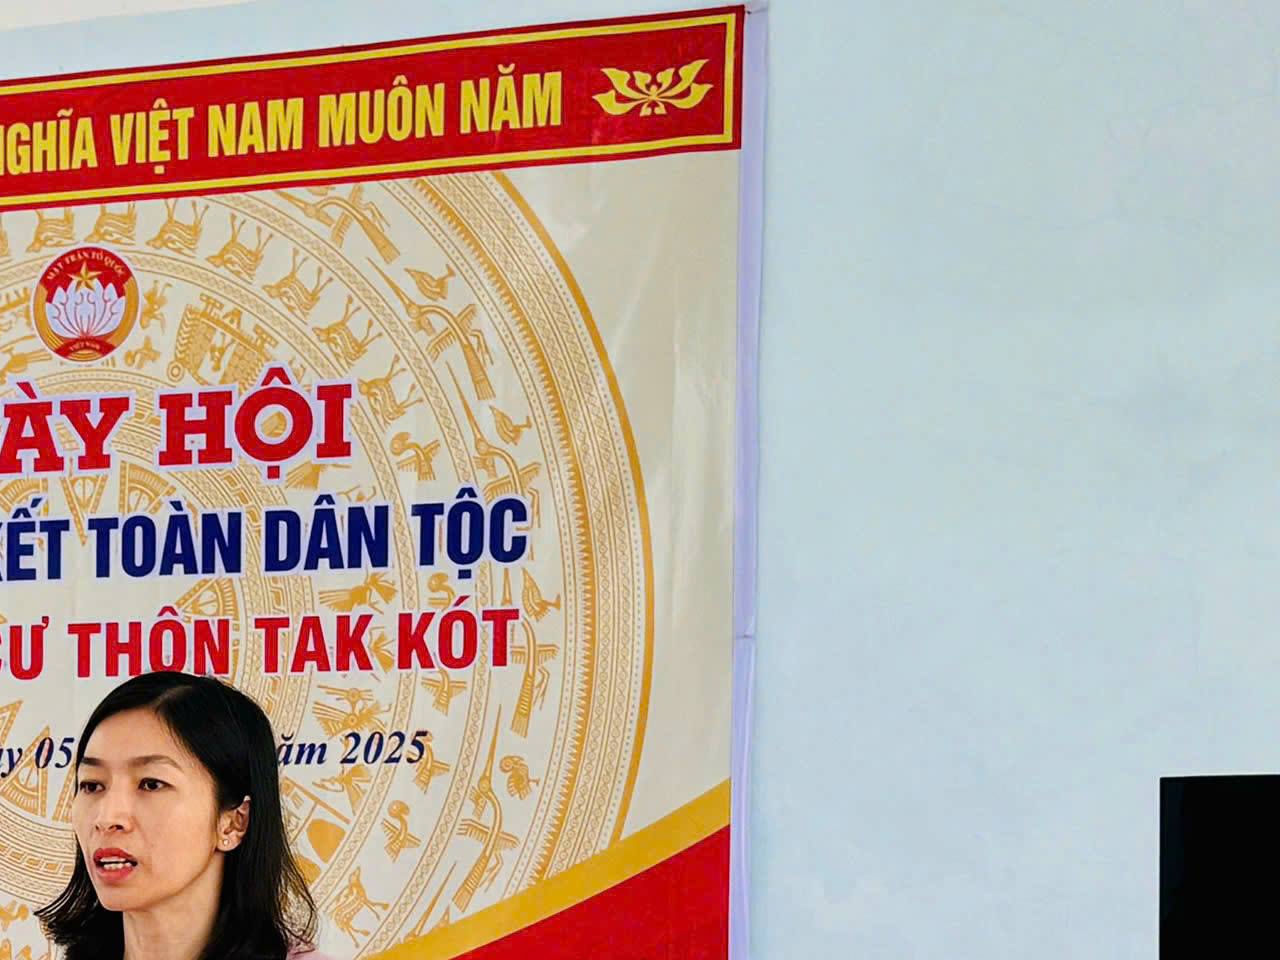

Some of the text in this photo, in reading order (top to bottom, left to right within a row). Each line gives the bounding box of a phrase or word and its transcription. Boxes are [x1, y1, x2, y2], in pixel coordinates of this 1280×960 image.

[110, 98, 195, 175] VIỆT
[207, 97, 304, 158] NAM
[318, 75, 445, 148] MUÔN
[460, 63, 562, 134] NĂM
[158, 366, 352, 480] HỘI
[87, 500, 242, 578] TOÀN
[264, 493, 389, 572] DÂN
[411, 486, 528, 580] TỘC
[67, 605, 231, 678] THÔN
[254, 614, 374, 674] TAK
[397, 595, 521, 671] KÓT
[35, 736, 75, 769] 05
[276, 730, 429, 766] ăm 2025
